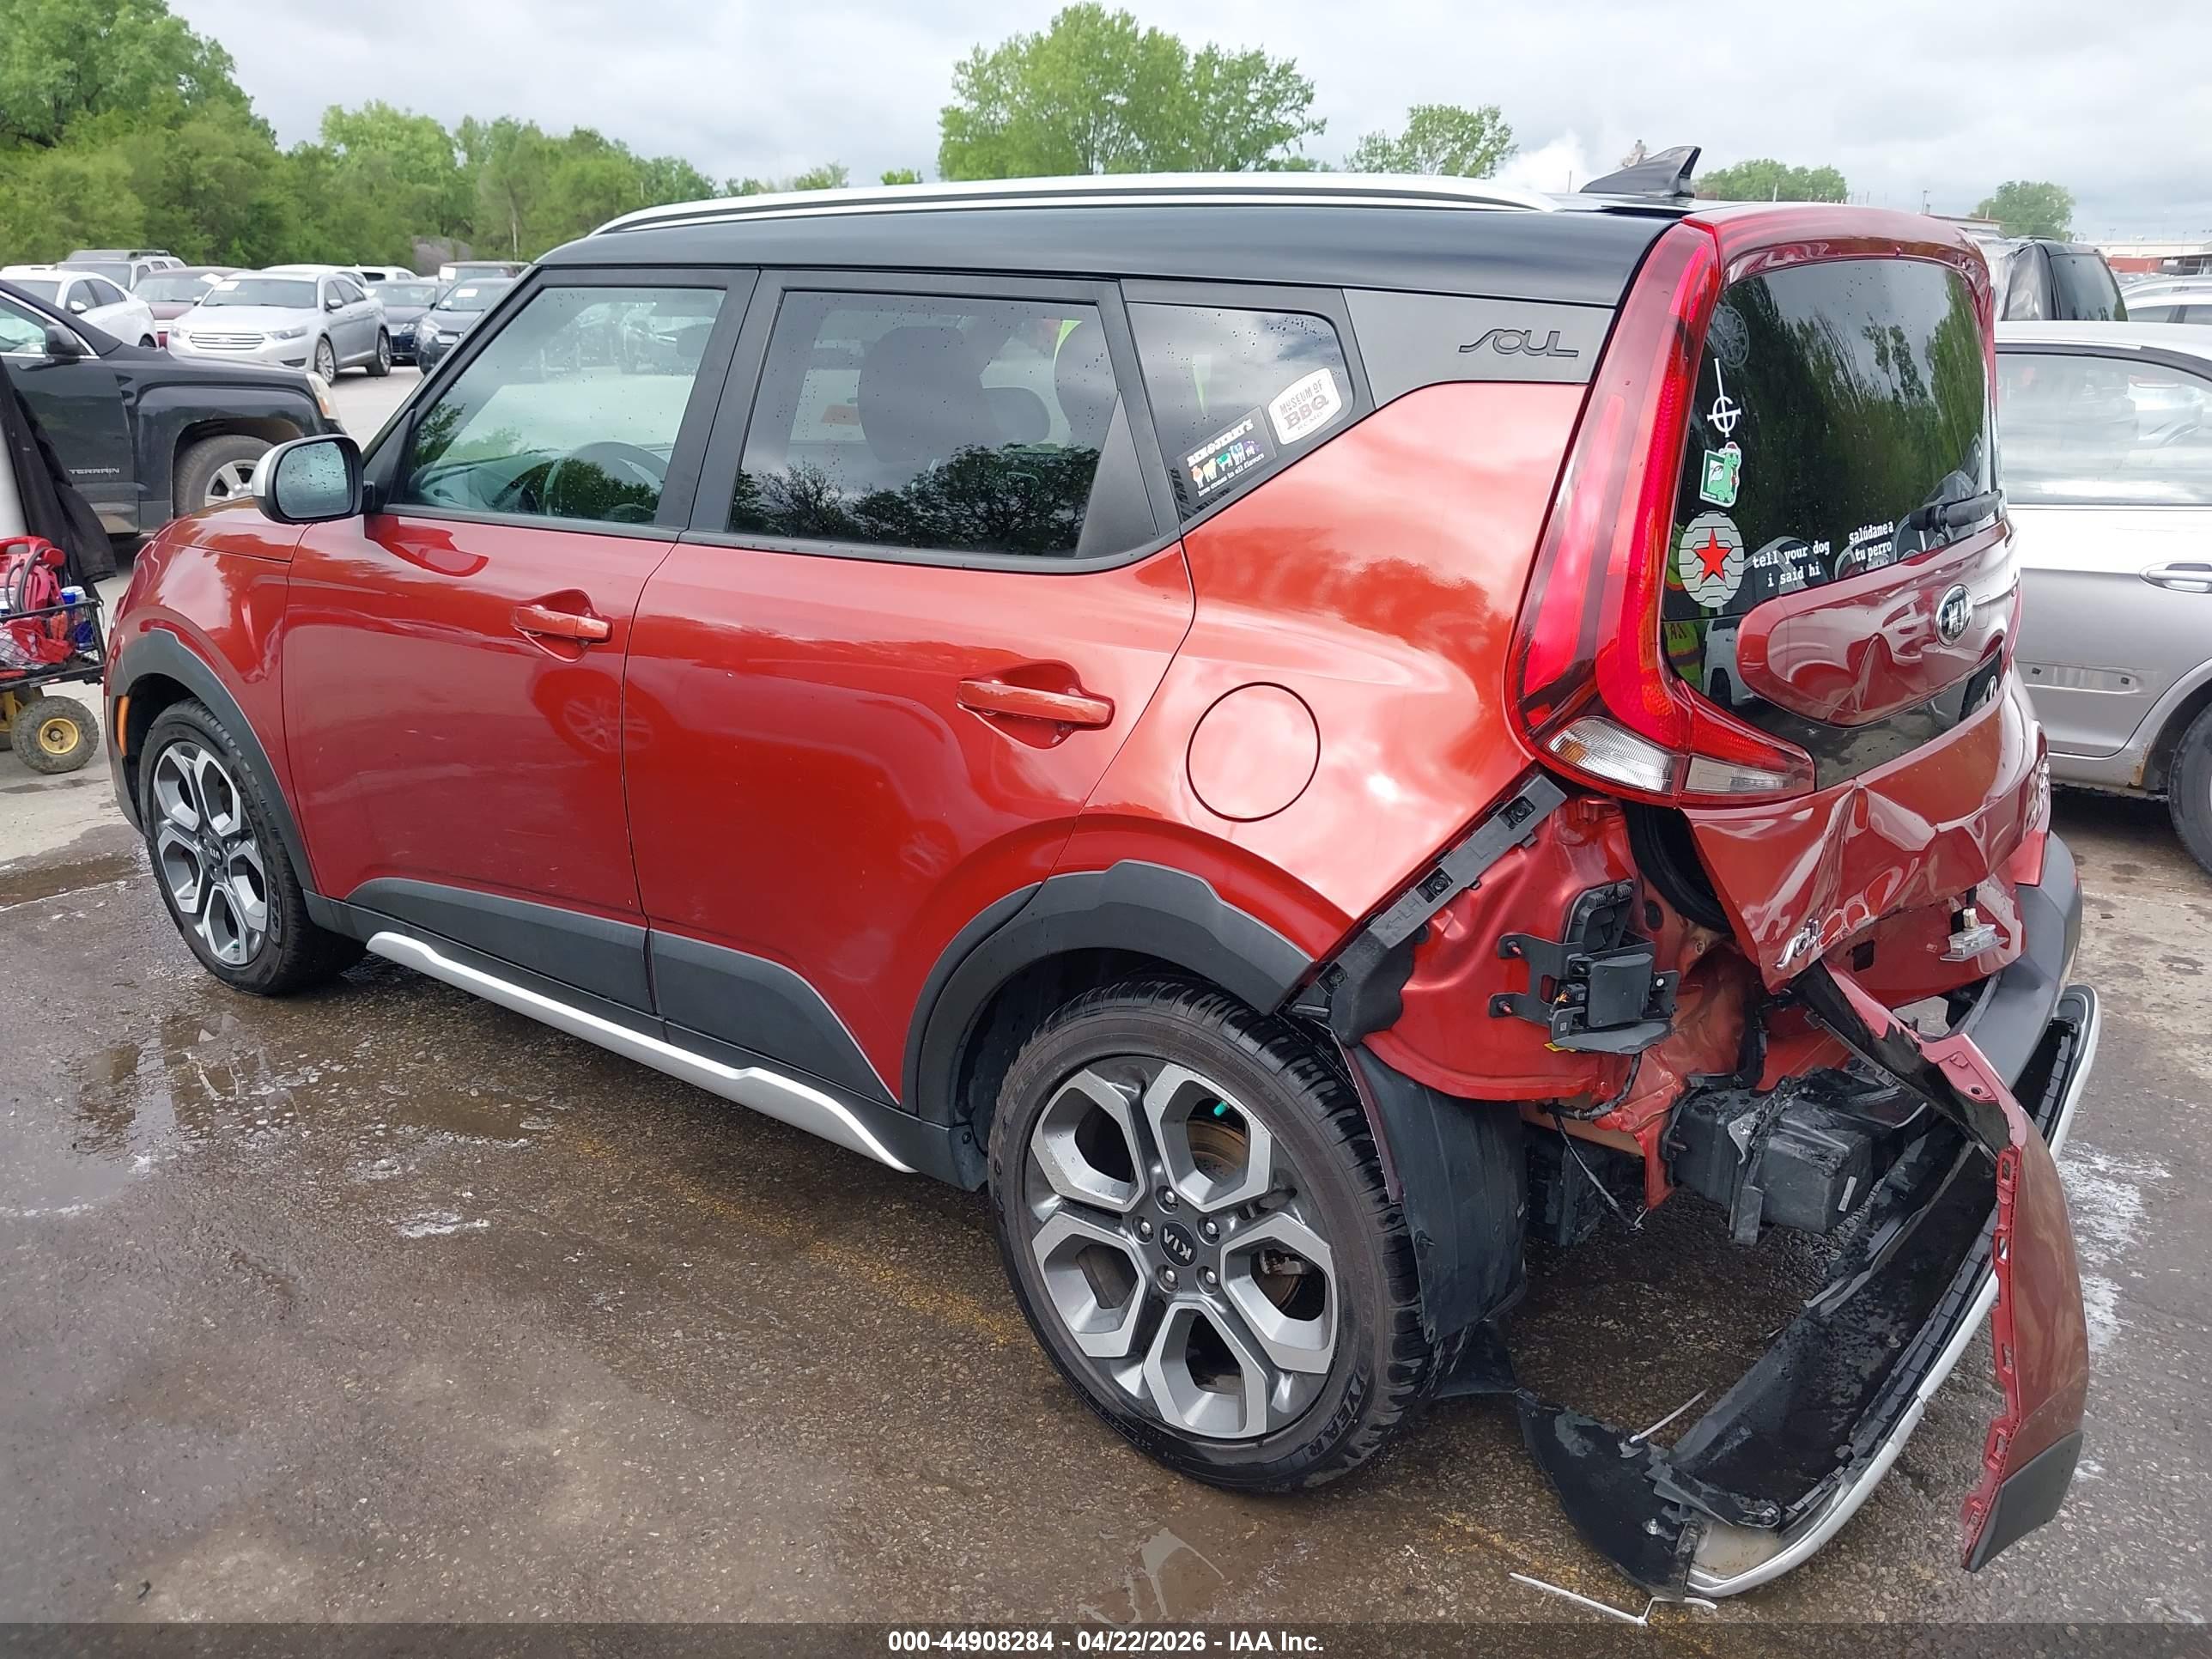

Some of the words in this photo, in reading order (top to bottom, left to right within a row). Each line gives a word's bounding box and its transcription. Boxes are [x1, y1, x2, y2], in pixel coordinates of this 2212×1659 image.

[1459, 329, 1579, 357] SOUL
[1279, 386, 1312, 416] MUSEUM
[1312, 380, 1322, 393] OF
[1284, 395, 1329, 429] BBQ
[1198, 486, 1210, 497] love
[1235, 465, 1244, 474] all
[1243, 453, 1265, 469] flavors
[1888, 520, 1894, 533] a
[1753, 550, 1779, 568] tell
[1784, 545, 1808, 564] your
[1813, 540, 1831, 556] dog
[1855, 547, 1866, 562] tu
[1868, 541, 1893, 560] perro
[1780, 566, 1804, 585] said
[1808, 562, 1821, 577] hi
[1164, 1227, 1193, 1261] KIA
